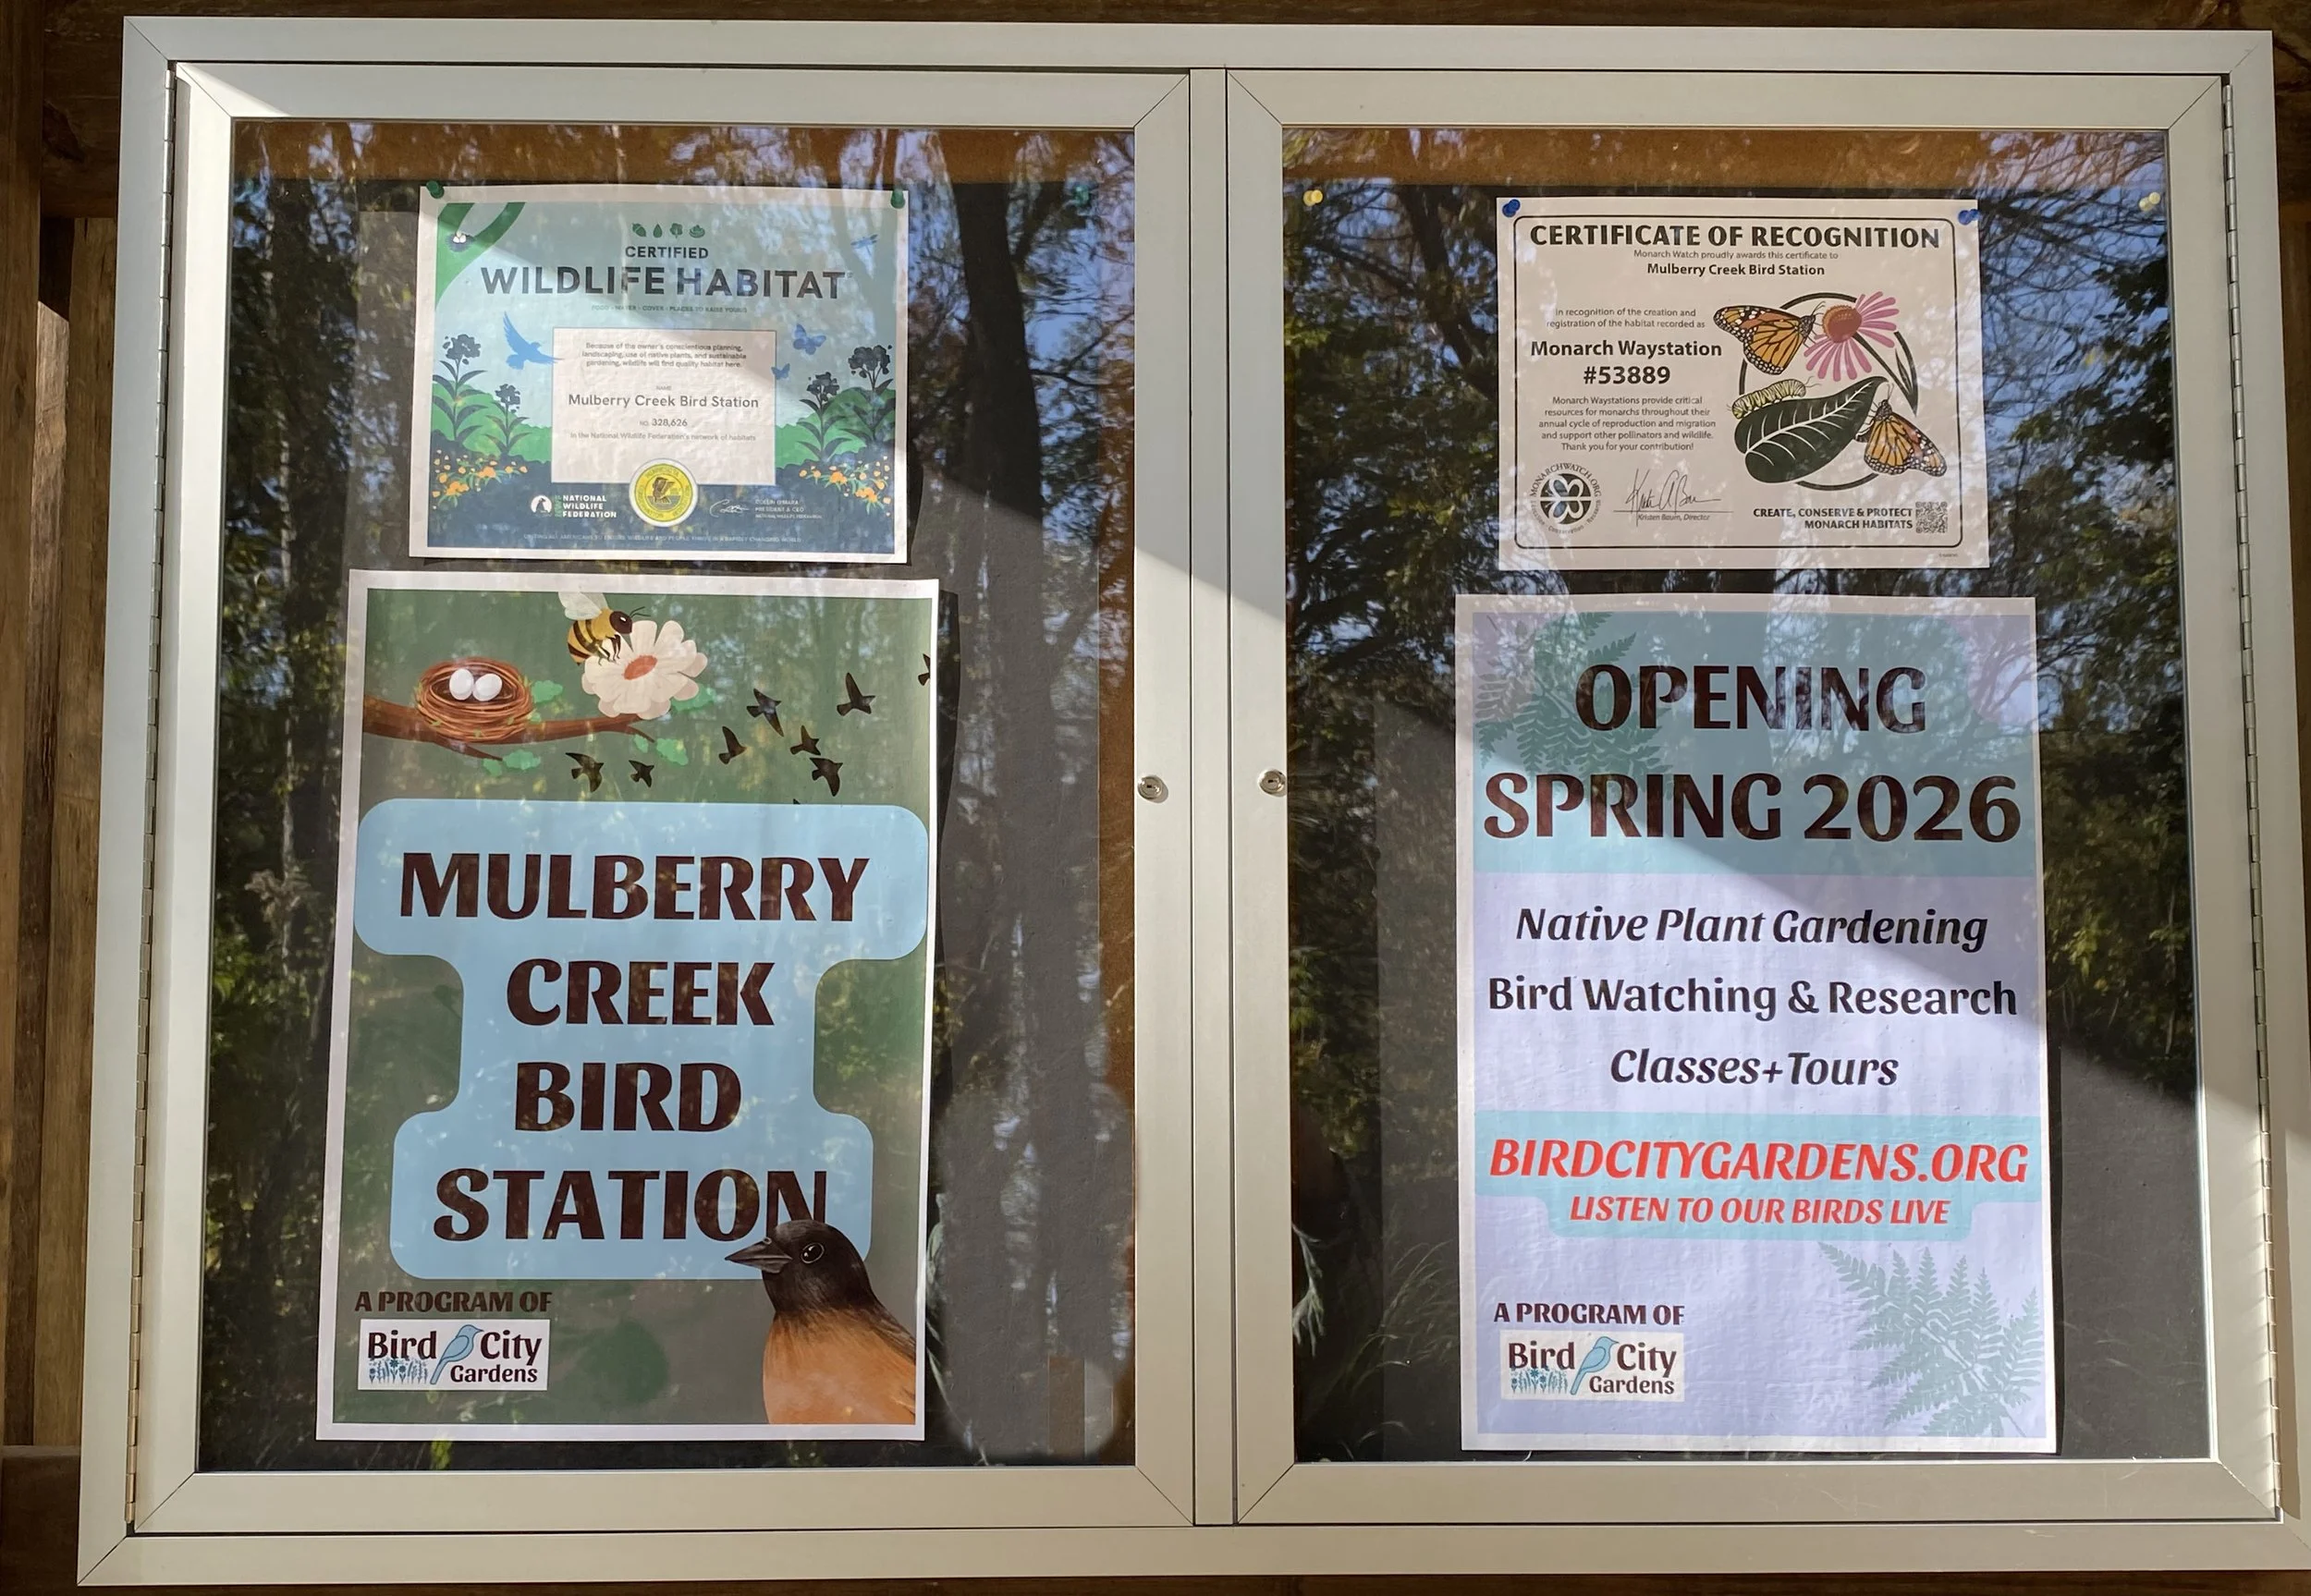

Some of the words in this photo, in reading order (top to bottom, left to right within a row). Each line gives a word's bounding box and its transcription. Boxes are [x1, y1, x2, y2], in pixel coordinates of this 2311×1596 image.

[1530, 225, 1701, 247] CERTIFICATE
[1707, 225, 1743, 247] OF
[1751, 226, 1939, 249] RECOGNITION
[625, 246, 709, 260] CERTIFIED
[1633, 249, 1671, 259] Monarch
[1672, 250, 1699, 259] Watch
[1701, 250, 1734, 261] proudly
[1735, 250, 1767, 260] awards
[1767, 250, 1784, 260] this
[1785, 251, 1828, 260] certificate
[1829, 251, 1839, 260] to
[1647, 263, 1706, 277] Mulberry
[1708, 263, 1746, 275] Creek
[1749, 264, 1775, 275] Bird
[1778, 264, 1825, 275] Station
[481, 266, 665, 295] WILDLIFE
[677, 267, 846, 299] HABITAT
[1565, 308, 1616, 318] recognition
[1617, 308, 1626, 316] of
[1628, 308, 1642, 316] the
[1644, 309, 1678, 317] creation
[1680, 309, 1696, 317] and
[1547, 320, 1596, 329] registration
[1597, 319, 1608, 327] of
[1608, 319, 1623, 327] the
[1624, 319, 1656, 328] habitat
[1657, 320, 1694, 328] recorded
[1530, 339, 1614, 357] Monarch
[1618, 340, 1722, 359] Waystation
[1583, 365, 1671, 385] #53889
[568, 394, 630, 408] Mulberry
[634, 395, 676, 407] Creek
[679, 395, 707, 408] Bird
[711, 396, 759, 408] Station
[1552, 396, 1589, 405] Monarch
[1590, 396, 1640, 407] Waystations
[1642, 396, 1673, 407] provide
[1675, 396, 1703, 405] critical
[651, 419, 688, 428] 328,626
[1585, 408, 1597, 416] for
[1598, 408, 1640, 416] monarchs
[1641, 408, 1690, 419] throughout
[1691, 408, 1710, 416] their
[1538, 420, 1568, 428] annual
[1569, 420, 1590, 430] cycle
[1592, 419, 1601, 428] of
[1602, 420, 1657, 430] reproduction
[1657, 420, 1674, 428] and
[1675, 420, 1717, 430] migration
[1541, 431, 1558, 439] and
[1559, 432, 1593, 441] support
[1594, 431, 1617, 439] other
[1618, 431, 1662, 441] pollinators
[1663, 431, 1680, 440] and
[1681, 431, 1714, 440] wildlife.
[1561, 443, 1586, 451] Thank
[1588, 445, 1605, 453] you
[1606, 443, 1618, 451] for
[1619, 445, 1638, 453] your
[1640, 443, 1694, 452] contribution!
[1529, 462, 1602, 497] MONARCHWATCH.ORG
[562, 510, 617, 518] FEDERATION
[1753, 508, 1796, 518] CREATE,
[1798, 508, 1855, 518] CONSERVE
[1856, 508, 1865, 518] &
[1866, 508, 1914, 518] PROTECT
[1804, 519, 1860, 530] MONARCH
[1862, 520, 1914, 530] HABITATS
[1575, 664, 1927, 733] OPENING
[1484, 772, 1782, 839] SPRING
[1803, 773, 2022, 844] 2026
[399, 852, 870, 922] MULBERRY
[1515, 906, 1648, 943] Native
[1655, 908, 1766, 944] Plant
[1772, 908, 1988, 954] Gardening
[506, 958, 776, 1027] CREEK
[1488, 977, 1572, 1012] Bird
[1583, 978, 1777, 1021] Watching
[1788, 980, 1820, 1015] &
[1828, 980, 2018, 1017] Research
[1609, 1048, 1900, 1087] Classes+Tours
[514, 1061, 742, 1134] BIRD
[1489, 1138, 2029, 1184] BIRDCITYGARDENS.ORG
[433, 1167, 828, 1243] STATION
[1570, 1195, 1669, 1223] LISTEN
[1677, 1197, 1714, 1224] TO
[1719, 1197, 1785, 1224] OUR
[1791, 1198, 1883, 1225] BIRDS
[1890, 1200, 1950, 1226] LIVE
[354, 1291, 373, 1312] A
[378, 1291, 514, 1313] PROGRAM
[519, 1291, 554, 1312] OF
[1494, 1302, 1511, 1323] A
[1516, 1303, 1647, 1325] PROGRAM
[1652, 1305, 1685, 1326] OF
[367, 1329, 438, 1360] Bird
[480, 1329, 544, 1367] City
[1508, 1340, 1576, 1371] Bird
[1617, 1341, 1678, 1379] City
[449, 1364, 539, 1383] Gardens
[1588, 1375, 1675, 1395] Gardens
